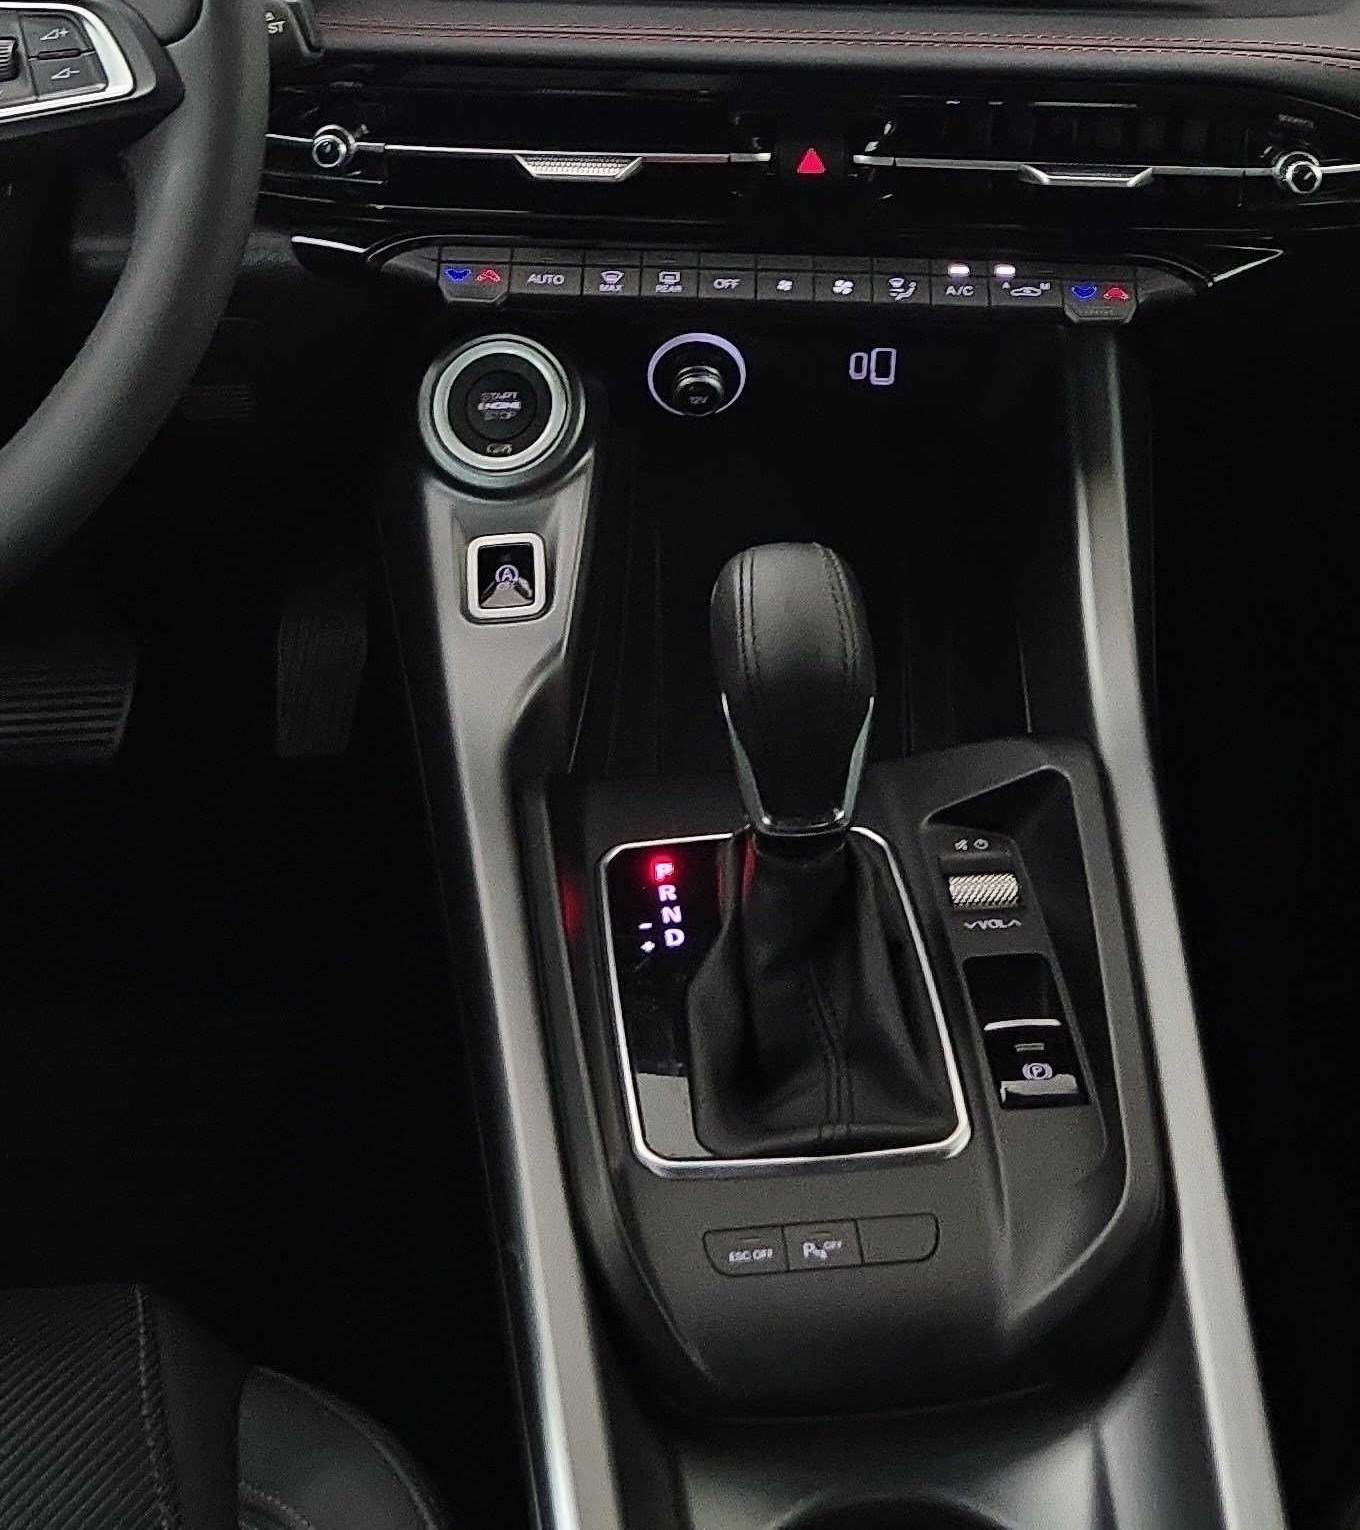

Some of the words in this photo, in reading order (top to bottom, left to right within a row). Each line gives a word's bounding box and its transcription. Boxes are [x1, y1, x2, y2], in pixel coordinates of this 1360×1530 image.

[526, 273, 565, 286] AUTO
[713, 278, 741, 290] OFF
[599, 283, 624, 293] MAX
[655, 284, 683, 294] REAR
[945, 285, 975, 297] A/C
[655, 862, 675, 882] P
[658, 884, 677, 902] R
[661, 905, 682, 924] N
[664, 928, 685, 947] D
[752, 1248, 774, 1261] OFF
